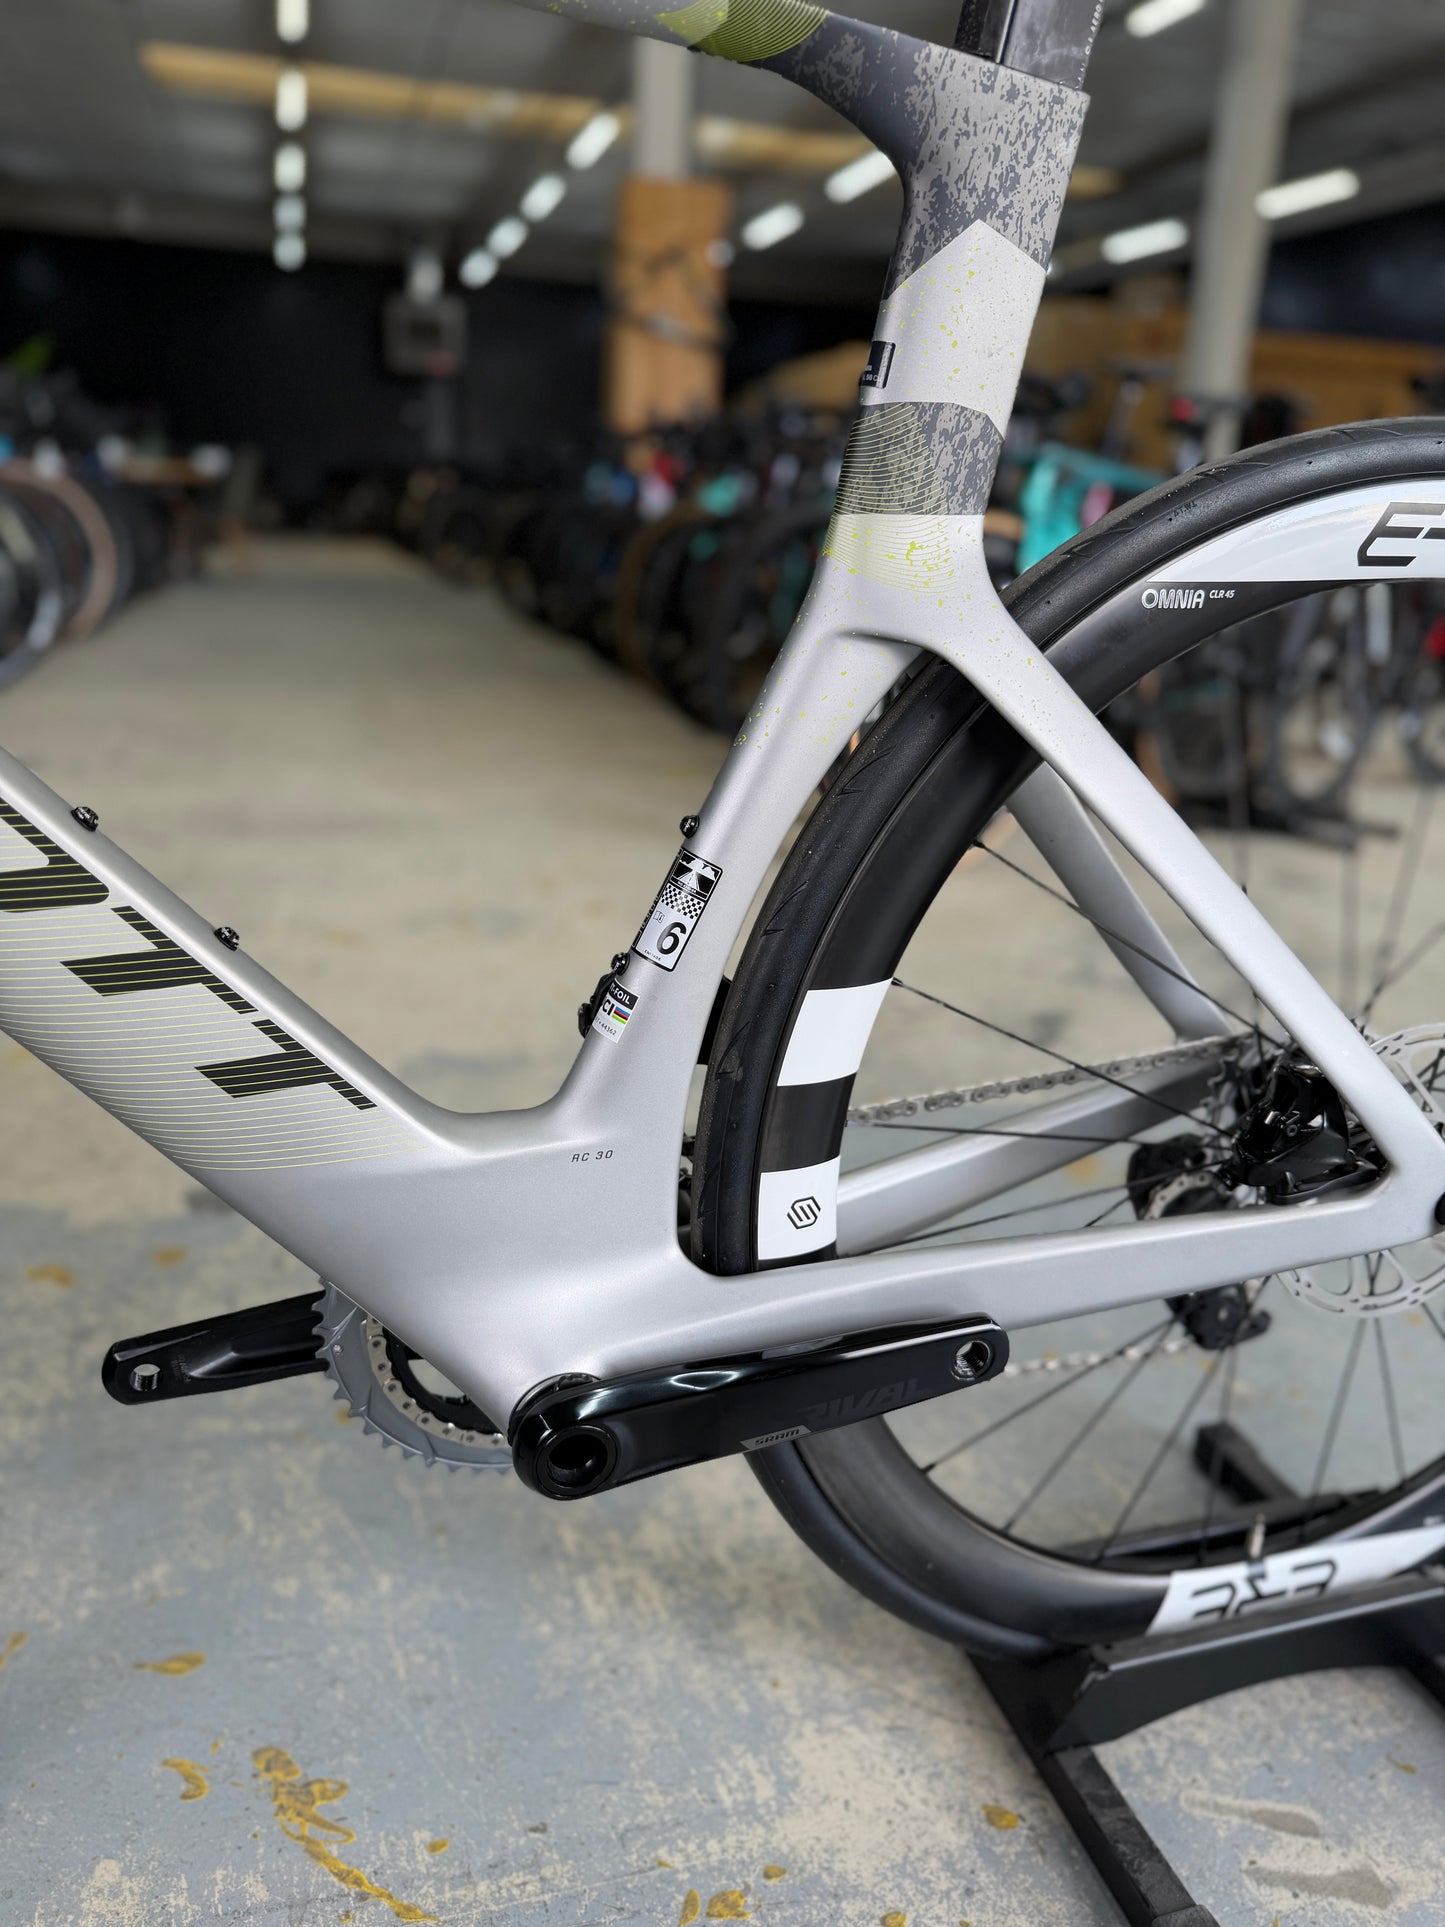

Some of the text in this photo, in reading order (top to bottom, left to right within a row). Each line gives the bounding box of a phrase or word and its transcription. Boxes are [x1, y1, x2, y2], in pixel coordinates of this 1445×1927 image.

[1141, 588, 1205, 609] OMNIA
[656, 922, 687, 955] 6
[601, 999, 615, 1016] CI
[571, 1149, 613, 1163] RC 30
[797, 1378, 930, 1423] RIVAL
[754, 1428, 801, 1446] SRAM
